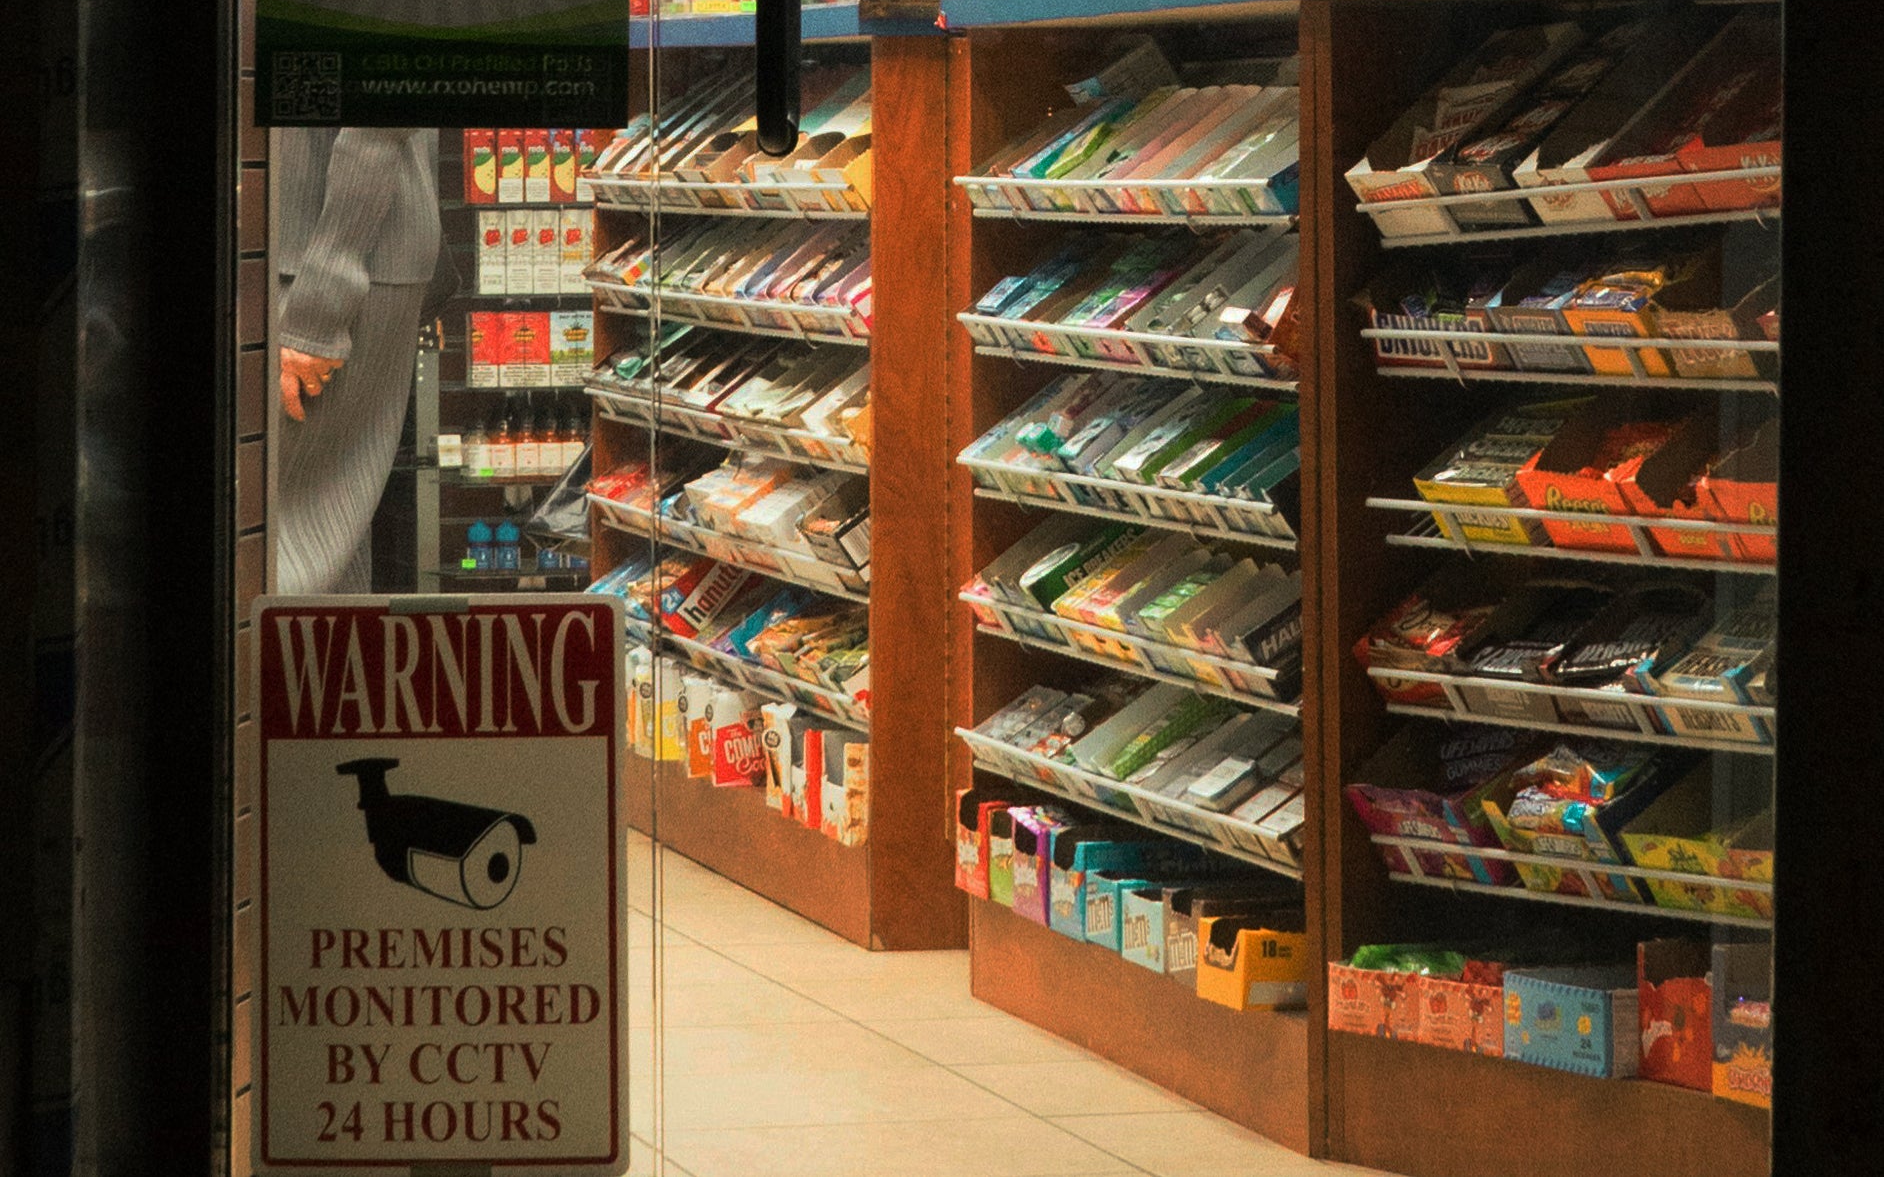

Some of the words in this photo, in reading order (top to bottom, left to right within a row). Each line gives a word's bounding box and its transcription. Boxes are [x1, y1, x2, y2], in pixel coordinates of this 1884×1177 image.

[1082, 526, 1138, 575] BREAKERS
[275, 610, 600, 736] WARNING
[310, 926, 568, 969] PREMISES
[1262, 939, 1277, 958] 18
[279, 984, 600, 1027] MONITORED
[326, 1043, 392, 1085] BY
[409, 1042, 553, 1085] CCTV
[317, 1101, 366, 1143] 24
[382, 1100, 562, 1143] HOURS
